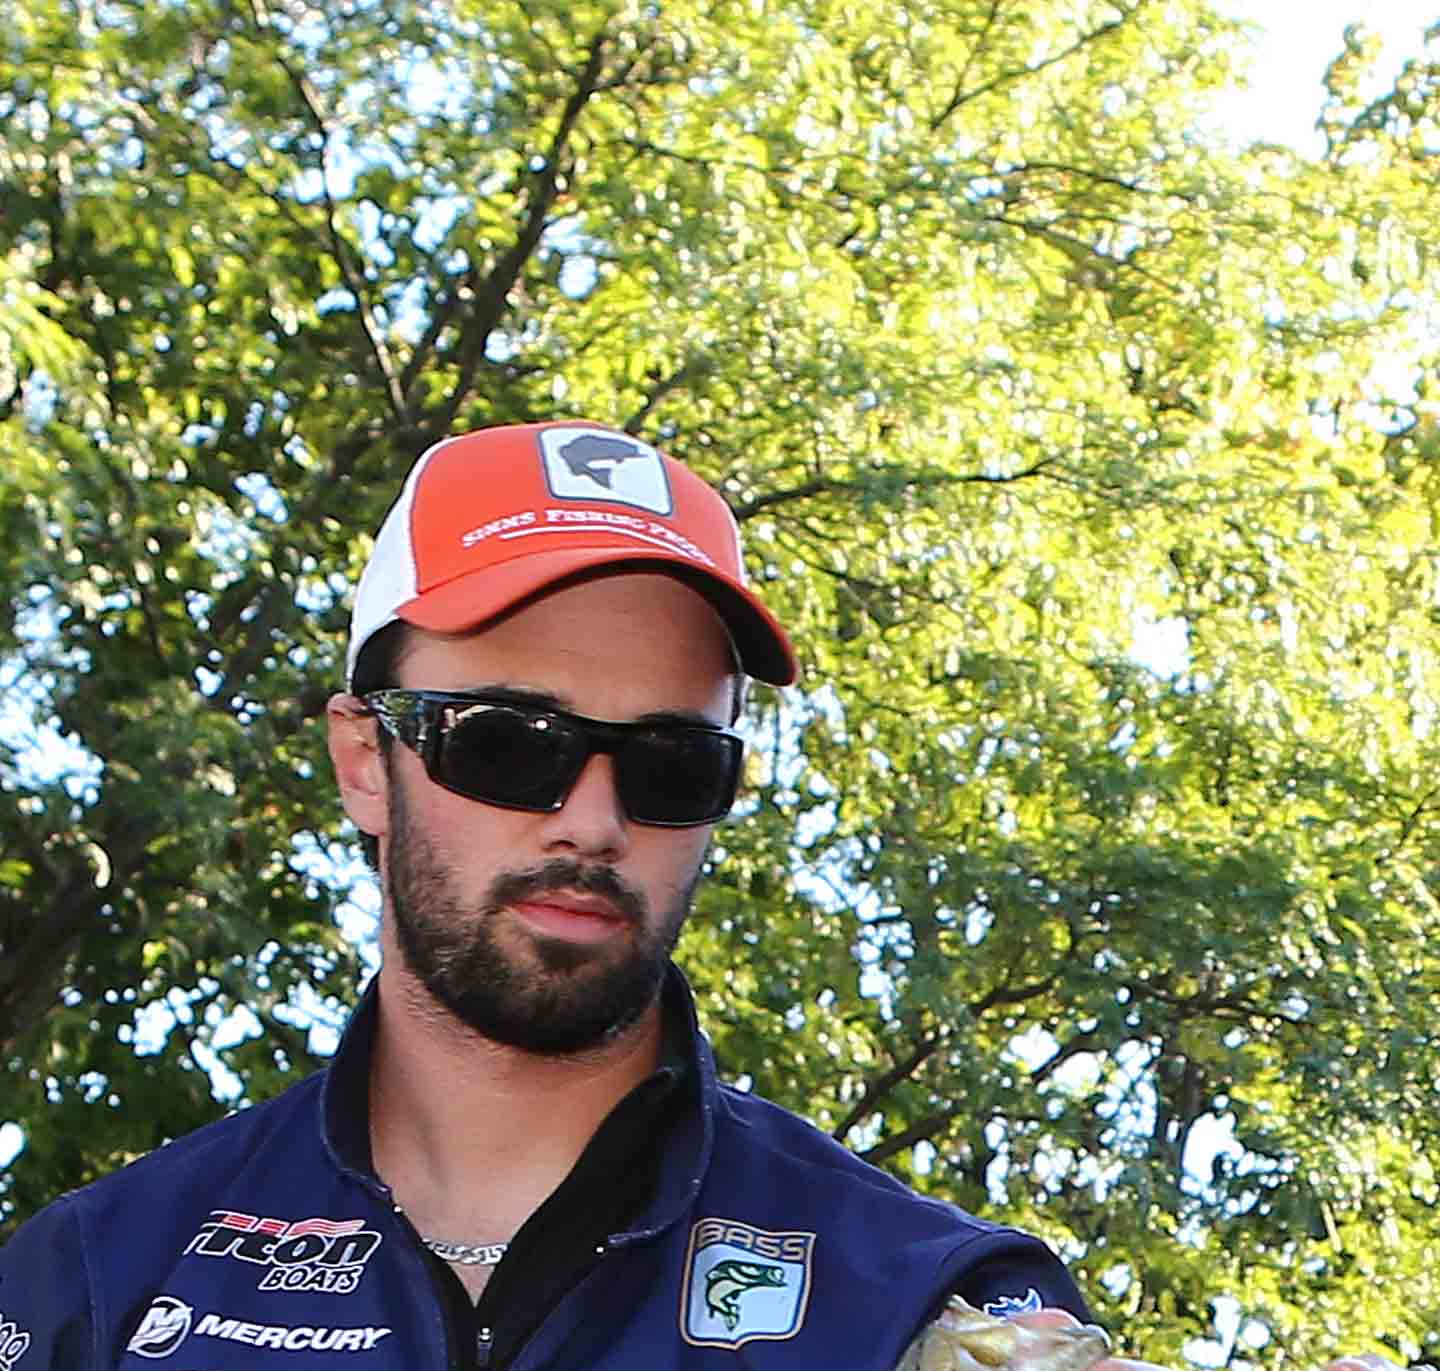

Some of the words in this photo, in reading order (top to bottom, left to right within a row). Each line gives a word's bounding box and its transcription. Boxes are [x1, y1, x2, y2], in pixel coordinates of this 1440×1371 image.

[697, 1222, 806, 1262] BASS
[258, 1264, 363, 1294] BOATS
[193, 1313, 393, 1351] MERCURY
